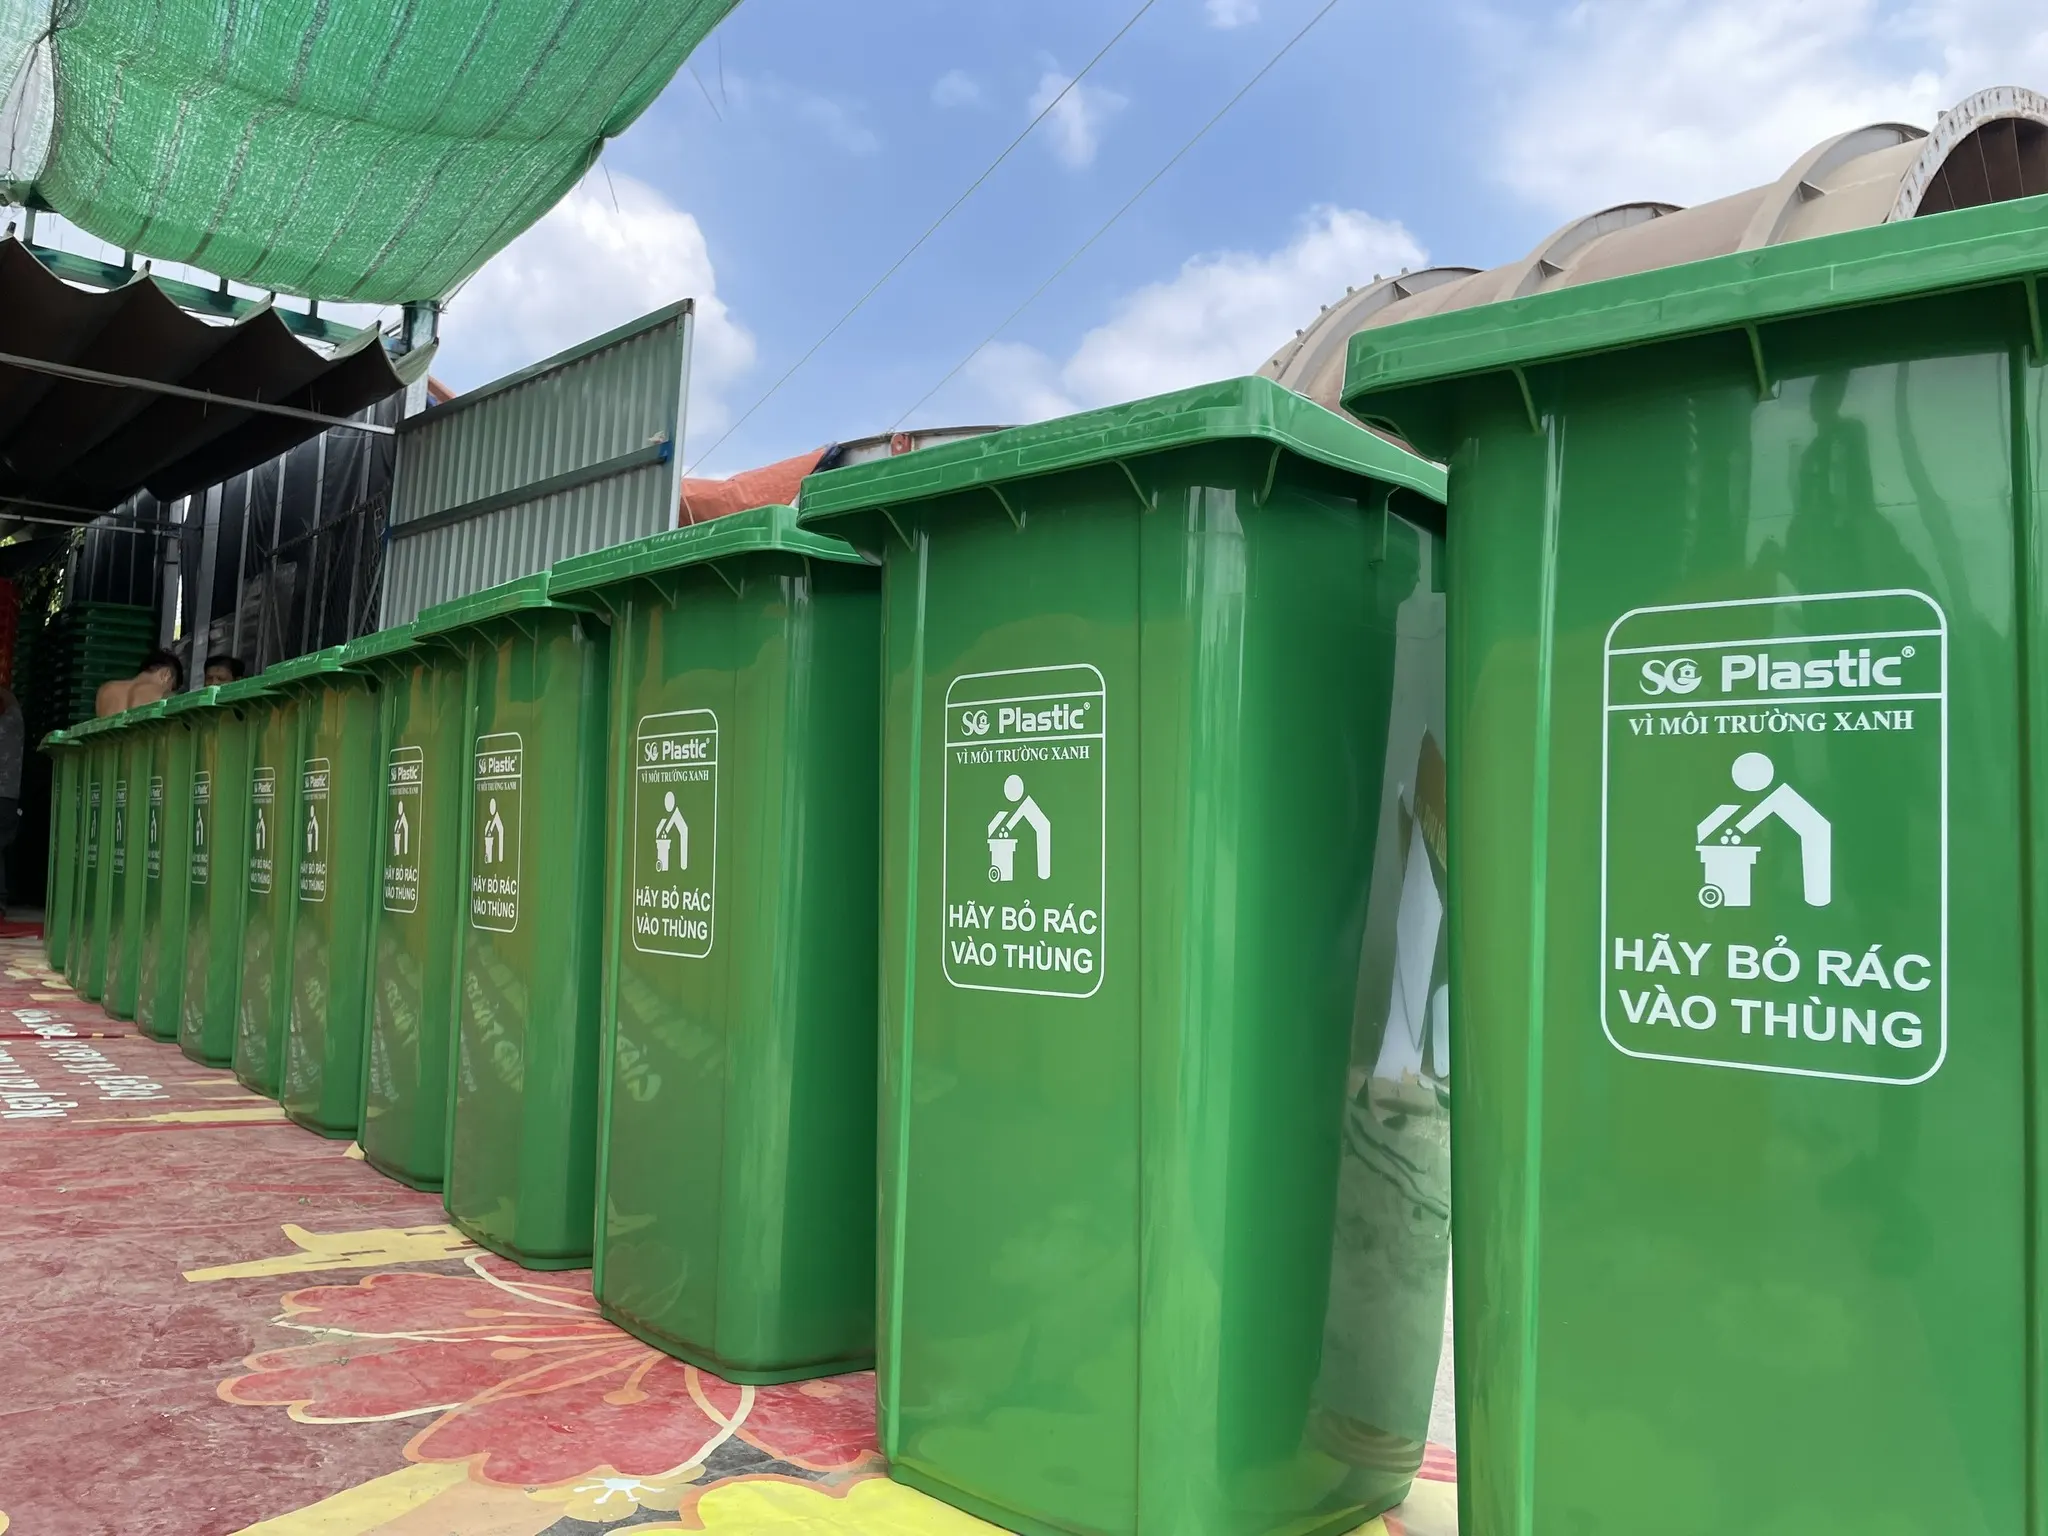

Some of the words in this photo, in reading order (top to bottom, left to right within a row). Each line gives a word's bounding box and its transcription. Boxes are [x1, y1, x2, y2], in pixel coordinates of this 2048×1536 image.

[1628, 712, 1654, 736] VÌ
[1659, 710, 1709, 736] MÔI
[1714, 707, 1827, 734] TRƯỜNG
[1833, 709, 1915, 732] XANH
[956, 747, 969, 765] VÌ
[970, 747, 994, 764] MÔI
[995, 744, 1049, 763] TRƯỜNG
[1051, 745, 1090, 761] XANH
[688, 769, 709, 782] XANH
[499, 876, 517, 895] RÁC
[636, 885, 659, 908] HÃY
[661, 884, 680, 910] BỎ
[682, 887, 711, 912] RÁC
[636, 912, 660, 936] VÀO
[661, 915, 708, 941] THÙNG
[949, 899, 995, 929] HÃY
[1001, 898, 1036, 932] BỎ
[1043, 902, 1098, 935] RÁC
[950, 935, 997, 967] VÀO
[1002, 940, 1093, 974] THÙNG
[1614, 932, 1713, 976] HÃY
[1727, 934, 1801, 983] BỎ
[1817, 943, 1932, 992] RÁC
[1618, 983, 1718, 1031] VÀO
[1730, 995, 1923, 1049] THÙNG
